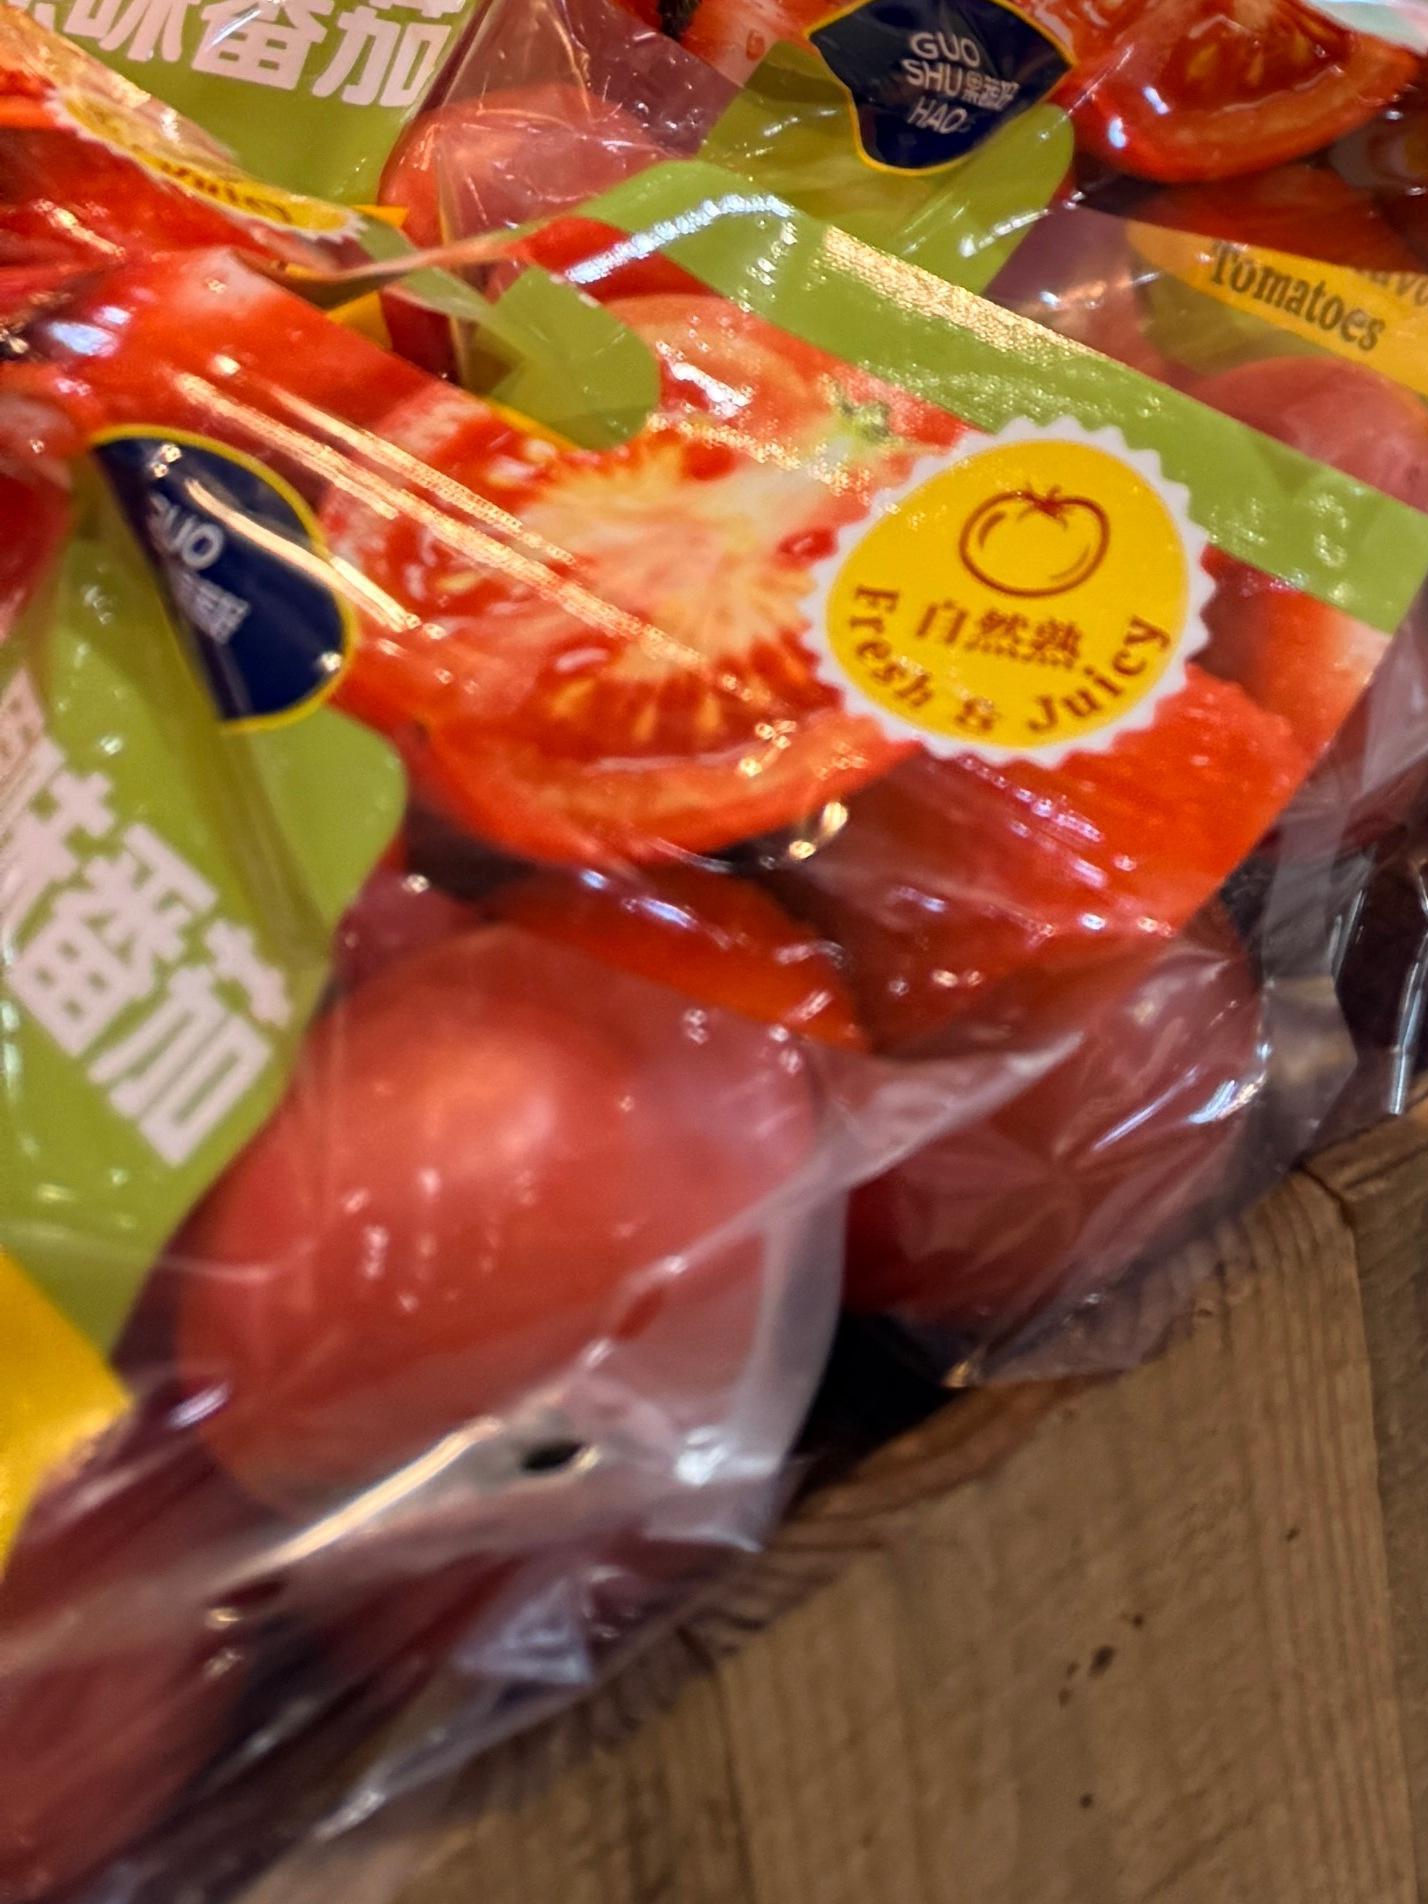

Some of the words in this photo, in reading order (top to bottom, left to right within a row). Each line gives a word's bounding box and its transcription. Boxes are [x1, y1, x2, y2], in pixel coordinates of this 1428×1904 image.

[901, 58, 963, 97] SHU
[910, 31, 981, 68] GUO
[906, 96, 969, 134] HAO
[1208, 239, 1386, 352] Tomatoes
[848, 583, 935, 710] Fresh
[953, 696, 996, 734] &
[1027, 613, 1173, 734] Juicy
[915, 596, 1083, 671] 自然熟
